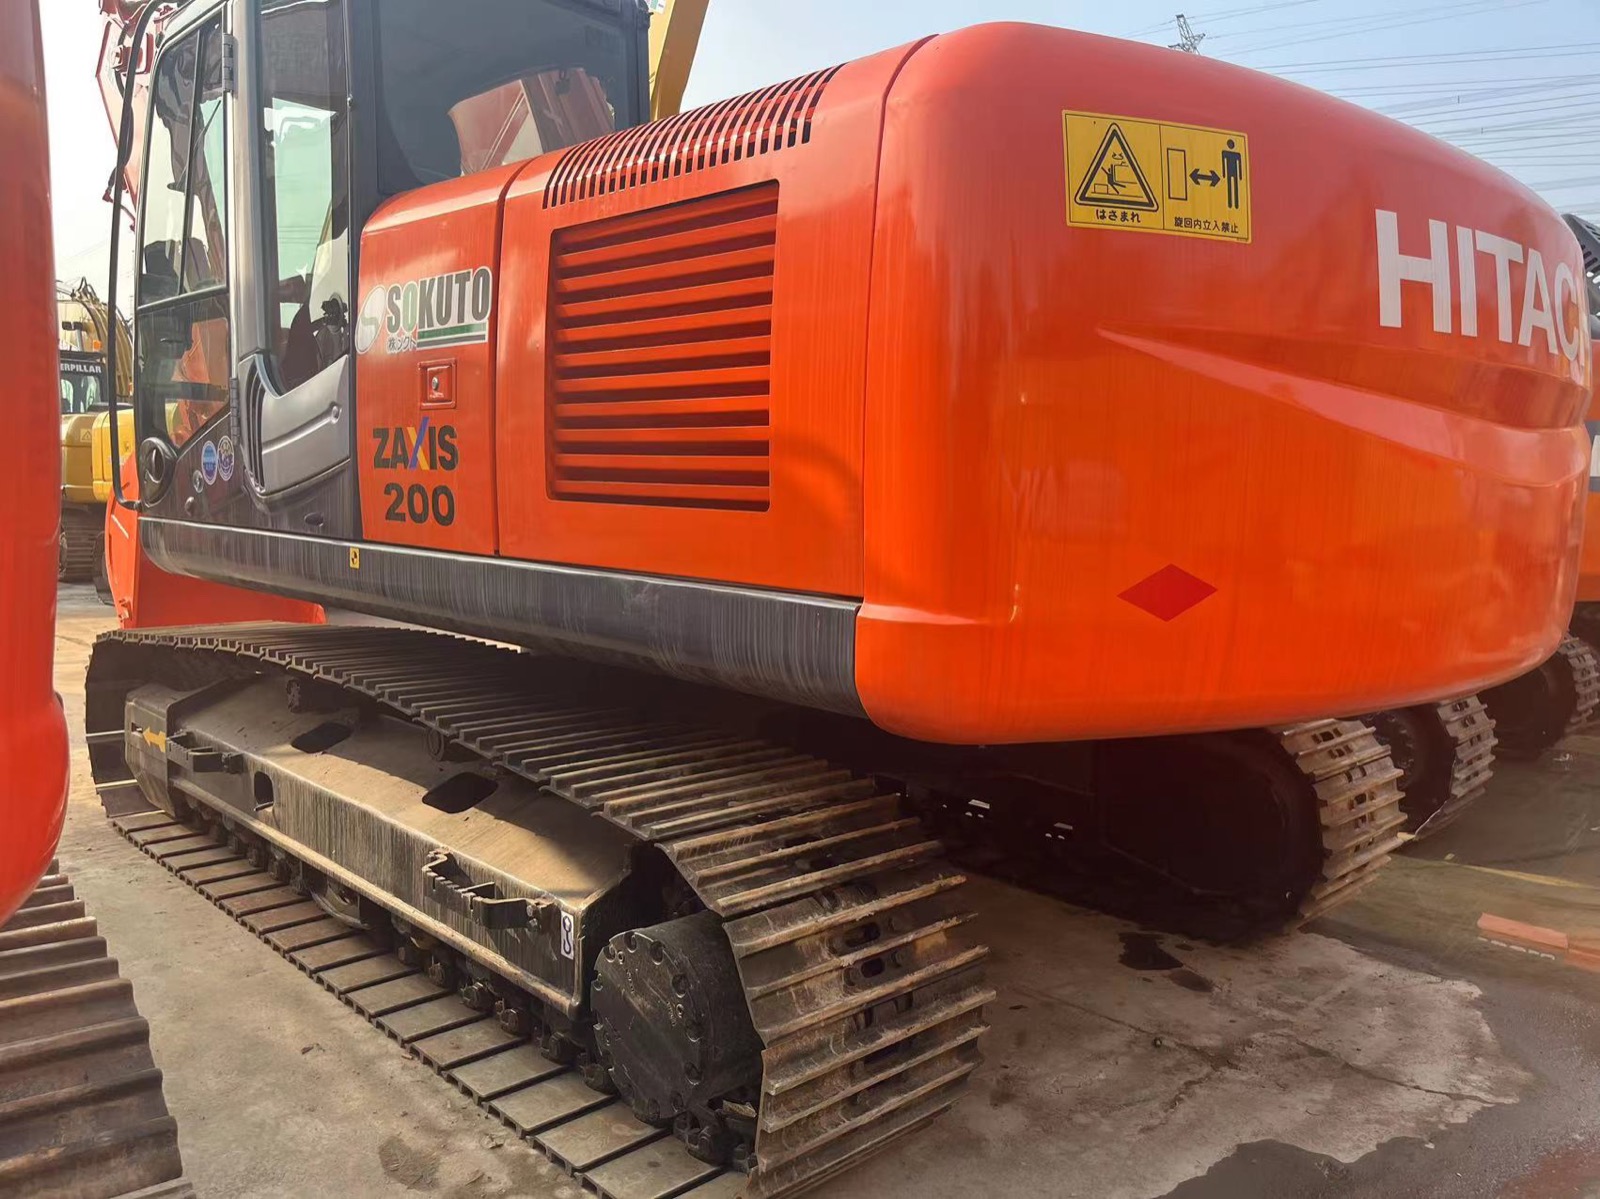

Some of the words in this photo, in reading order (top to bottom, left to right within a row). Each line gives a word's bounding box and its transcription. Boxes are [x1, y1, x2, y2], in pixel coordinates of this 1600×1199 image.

[1096, 208, 1141, 223] はさまれ
[1174, 216, 1239, 234] 旋回内立入禁止
[386, 266, 491, 334] SOKUTO
[1374, 208, 1584, 366] HITAC
[60, 362, 102, 373] ERPILLAR
[372, 416, 459, 471] ZAXIS
[384, 482, 455, 527] 200
